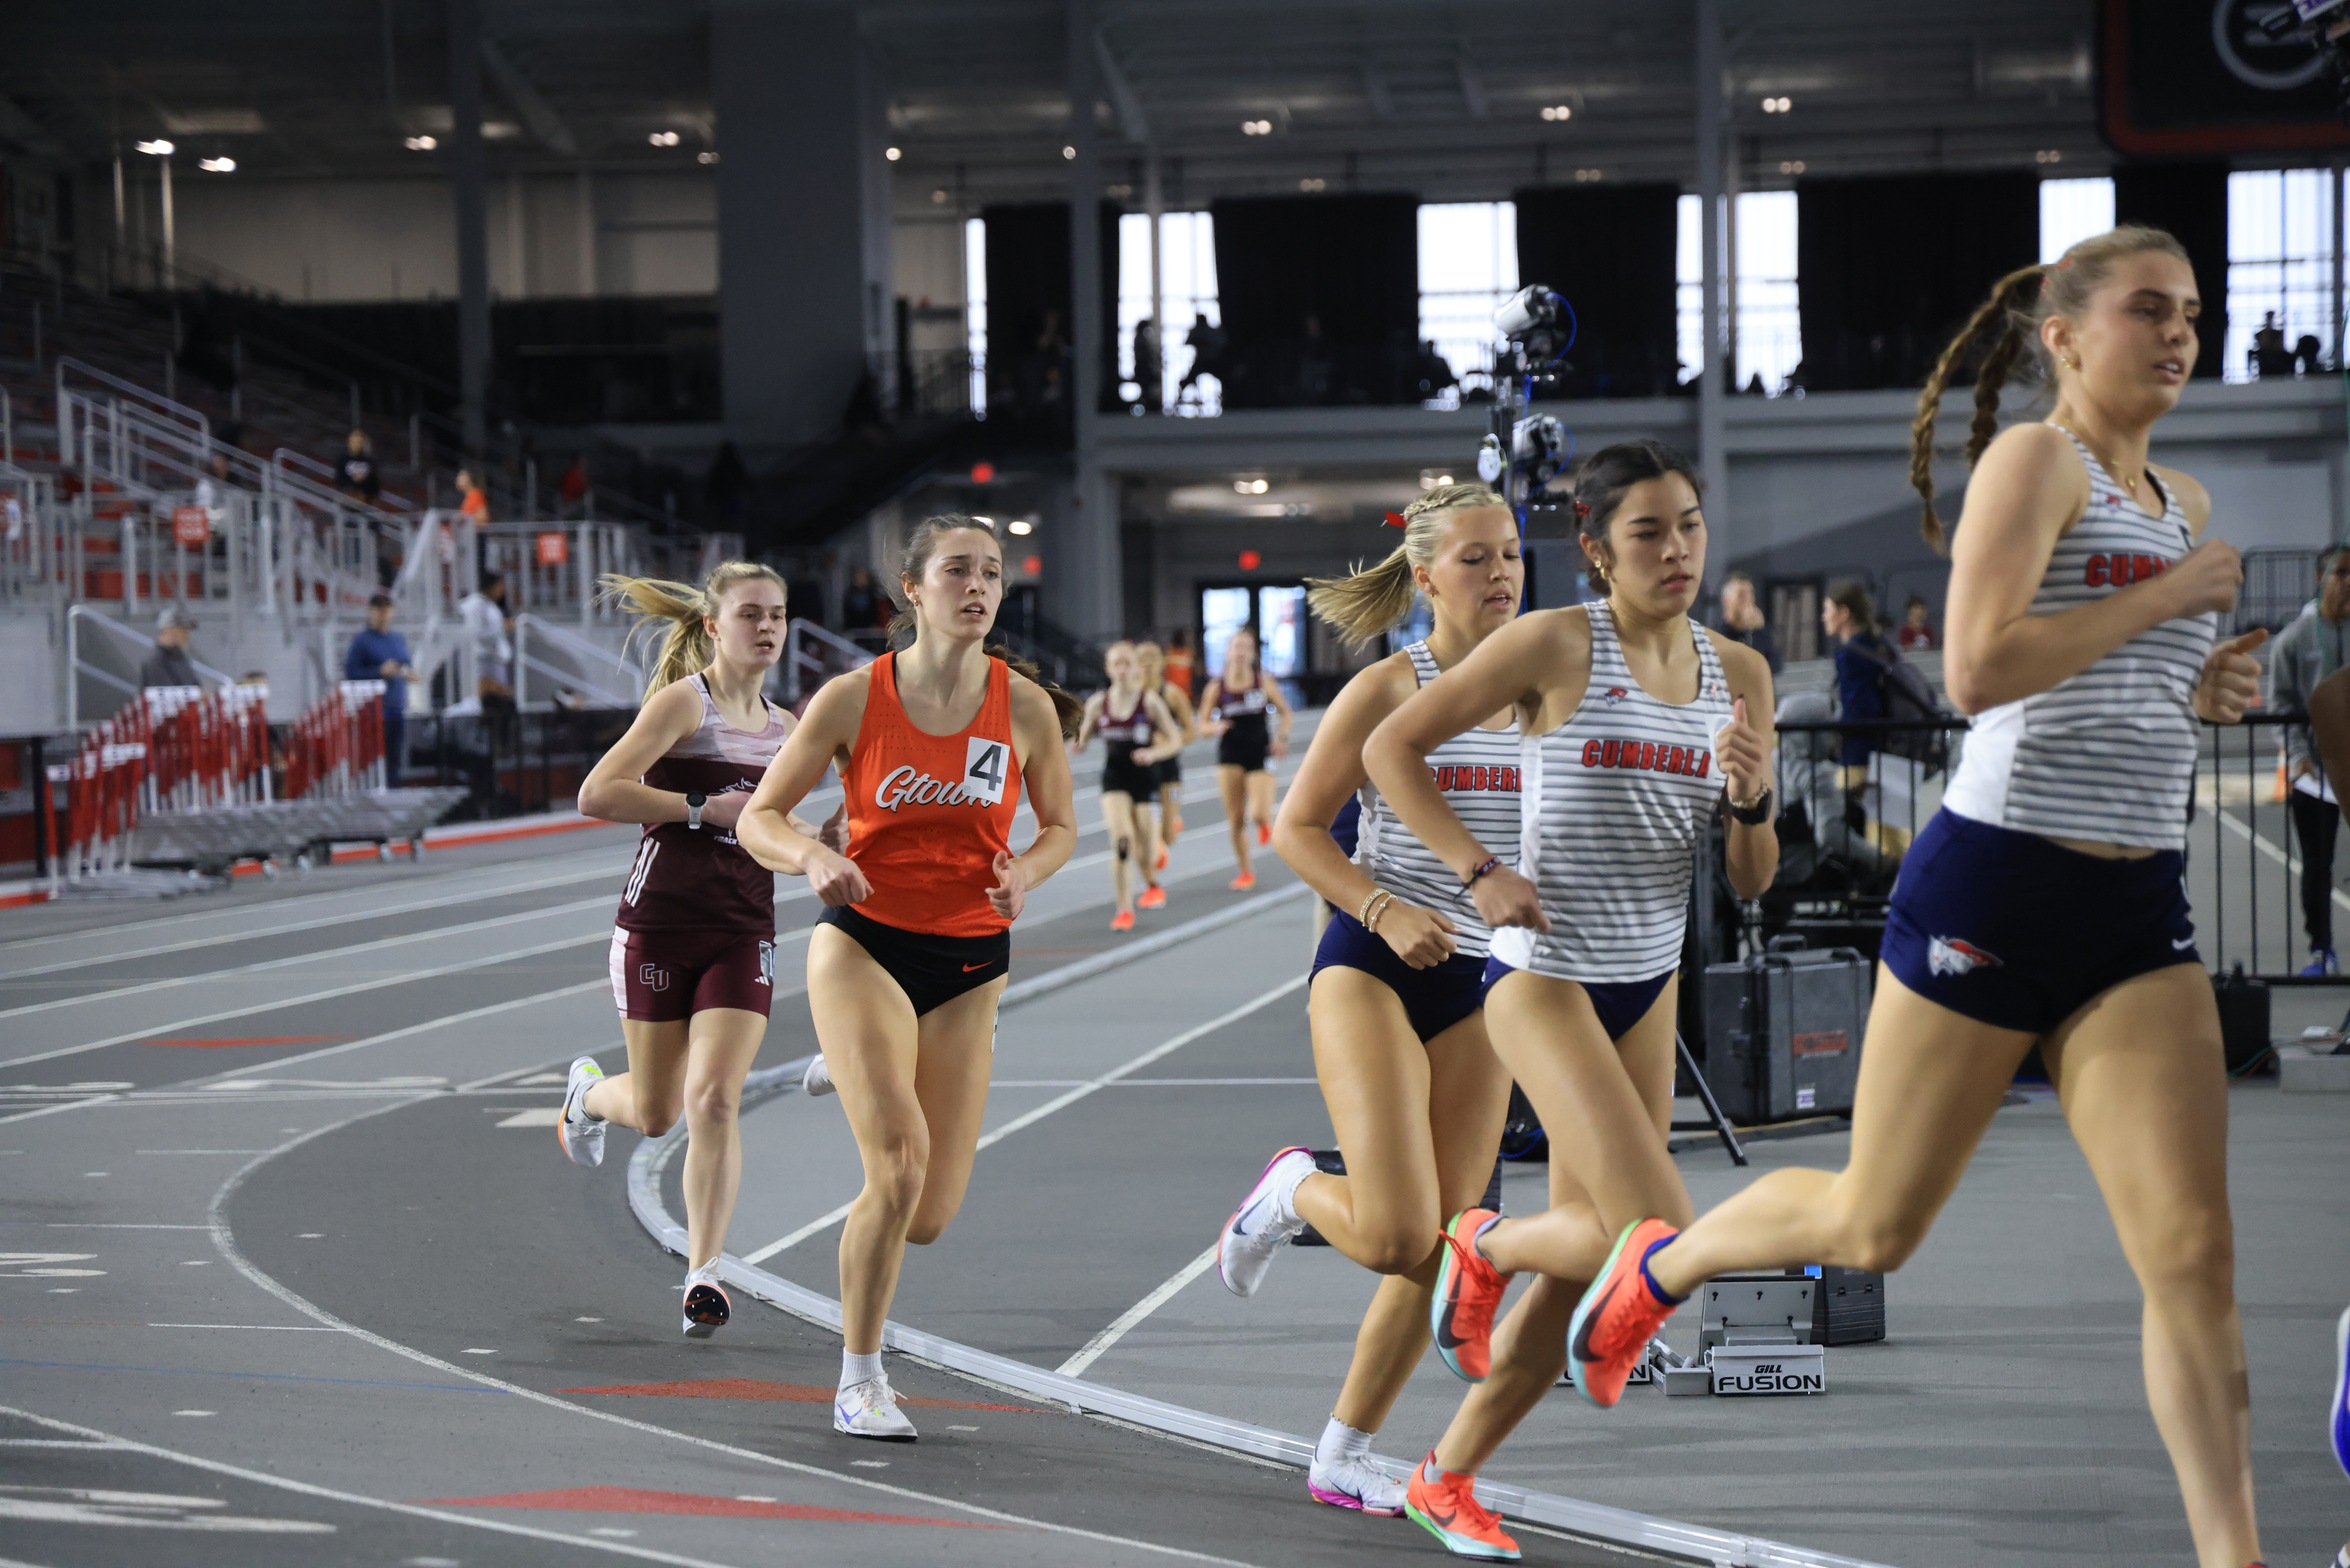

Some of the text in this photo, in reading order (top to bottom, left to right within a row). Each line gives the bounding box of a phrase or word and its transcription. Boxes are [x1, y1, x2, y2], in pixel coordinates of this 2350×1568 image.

[969, 744, 1002, 792] 4
[1581, 739, 1711, 779] CUMBERLA
[1718, 1374, 1822, 1392] FUSION
[1754, 1364, 1783, 1374] GILL
